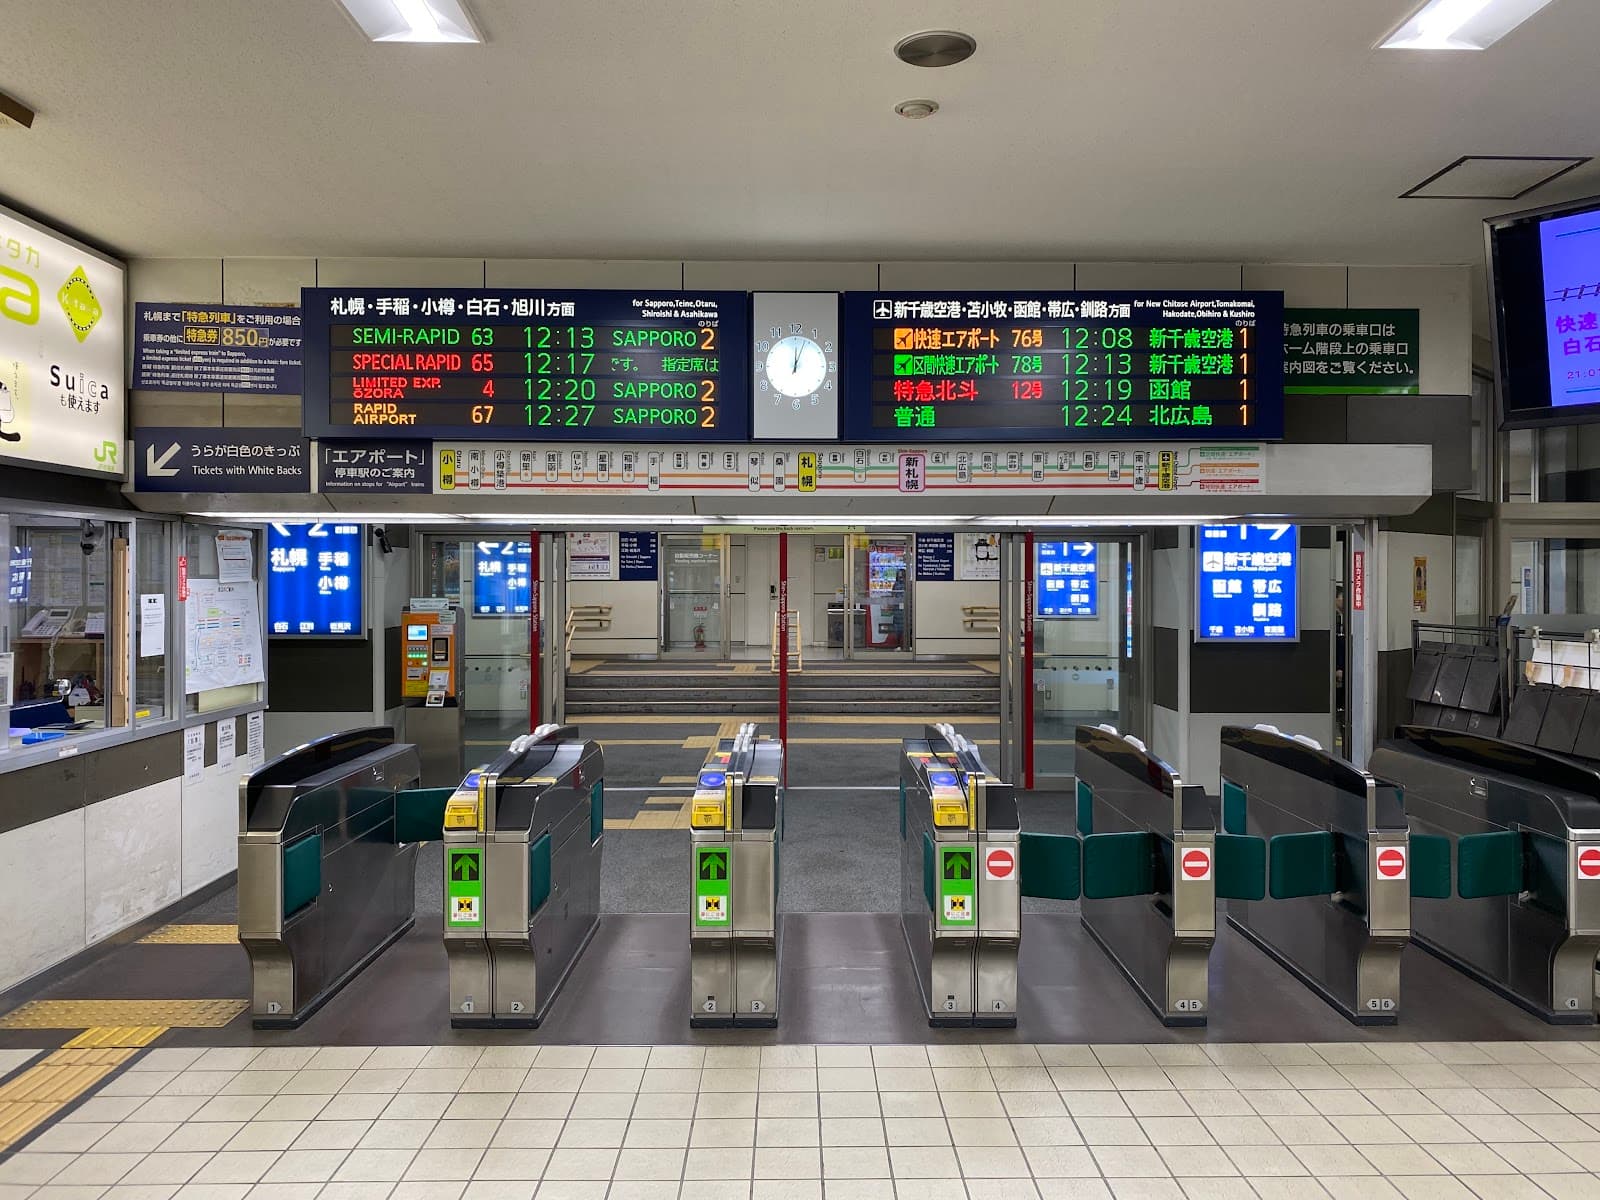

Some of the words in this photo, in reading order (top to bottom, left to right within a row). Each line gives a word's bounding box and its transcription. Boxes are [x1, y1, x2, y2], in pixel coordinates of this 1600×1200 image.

[1134, 300, 1144, 308] for
[1146, 300, 1160, 308] New
[1162, 300, 1188, 308] Chitose
[144, 310, 301, 326] 札幌まで「特急列車」をご利用の場合
[642, 310, 672, 318] Shiroishi
[674, 310, 679, 318] &
[680, 310, 718, 318] Asahikawa
[1222, 310, 1228, 318] &
[1230, 310, 1255, 318] Kushiro
[698, 320, 719, 328] のりば
[790, 324, 802, 334] 12
[1555, 312, 1598, 334] 快速
[186, 328, 218, 342] 特急券
[222, 328, 268, 348] 850円
[269, 338, 302, 347] が必要です
[352, 328, 460, 345] SEMI-RAPID
[472, 328, 494, 346] 63
[524, 326, 594, 348] 12:13
[612, 330, 697, 347] SAPPORO
[701, 328, 715, 350] 2
[770, 327, 782, 338] 11
[914, 328, 1000, 350] 快速エアポート
[1012, 329, 1043, 347] 76号
[1062, 328, 1133, 348] 12:08
[1150, 328, 1233, 348] 新千歳空港
[1240, 328, 1247, 348] 1
[757, 341, 770, 352] 10
[825, 342, 832, 352] 2
[1563, 335, 1600, 356] 白石
[352, 354, 413, 371] SPECIAL
[416, 354, 461, 371] RAPID
[472, 354, 494, 372] 65
[524, 352, 595, 374] 12:17
[662, 356, 719, 372] 指定席は
[914, 354, 1000, 376] 区間快速エアポート
[1012, 356, 1043, 374] 78号
[1062, 354, 1132, 374] 12:13
[1150, 354, 1233, 374] 新千歳空港
[1240, 353, 1247, 374] 1
[50, 364, 108, 400] Suica
[353, 377, 408, 388] LIMITED
[413, 377, 442, 388] EXP.
[482, 380, 494, 398] 4
[524, 378, 596, 400] 12:20
[613, 382, 697, 398] SAPPORO
[702, 380, 715, 402] 2
[760, 380, 768, 391] 8
[824, 380, 832, 390] 4
[894, 380, 979, 402] 特急北斗
[1012, 380, 1043, 399] 12号
[1062, 379, 1132, 400] 12:19
[1149, 379, 1192, 400] 函館
[1240, 378, 1247, 400] 1
[60, 394, 100, 414] も使えます
[774, 394, 782, 405] 7
[792, 399, 800, 410] 6
[811, 394, 820, 405] 5
[353, 404, 397, 414] RAPID
[353, 414, 416, 424] AIRPORT
[472, 406, 494, 424] 67
[524, 404, 596, 426] 12:27
[613, 408, 697, 424] SAPPORO
[702, 406, 715, 428] 2
[894, 406, 936, 428] 普通
[1062, 404, 1132, 426] 12:24
[1149, 404, 1212, 426] 北広島
[1240, 404, 1247, 426] 1
[94, 440, 117, 464] JR
[325, 448, 426, 466] 「エアポート」
[522, 453, 530, 470] 朝里
[573, 453, 582, 472] ほしみ
[958, 456, 966, 478] 北広島
[1136, 454, 1144, 485] 南千歳
[192, 466, 223, 474] Tickets
[226, 466, 245, 474] with
[248, 466, 274, 474] White
[277, 466, 302, 474] Backs
[334, 468, 416, 478] 停車駅のご案内
[442, 454, 453, 486] 小樽
[470, 453, 478, 487] 南小樽
[650, 457, 658, 484] 手稲
[801, 456, 812, 488] 札幌
[906, 456, 918, 490] 新札幌
[271, 548, 308, 567] 札幌
[271, 1004, 275, 1012] 1
[466, 1003, 471, 1011] 1
[708, 1002, 714, 1010] 2
[754, 1002, 760, 1010] 3
[948, 1002, 953, 1010] 3
[995, 1002, 1000, 1010] 4
[1372, 1000, 1376, 1008] 5
[1384, 1000, 1388, 1008] 6
